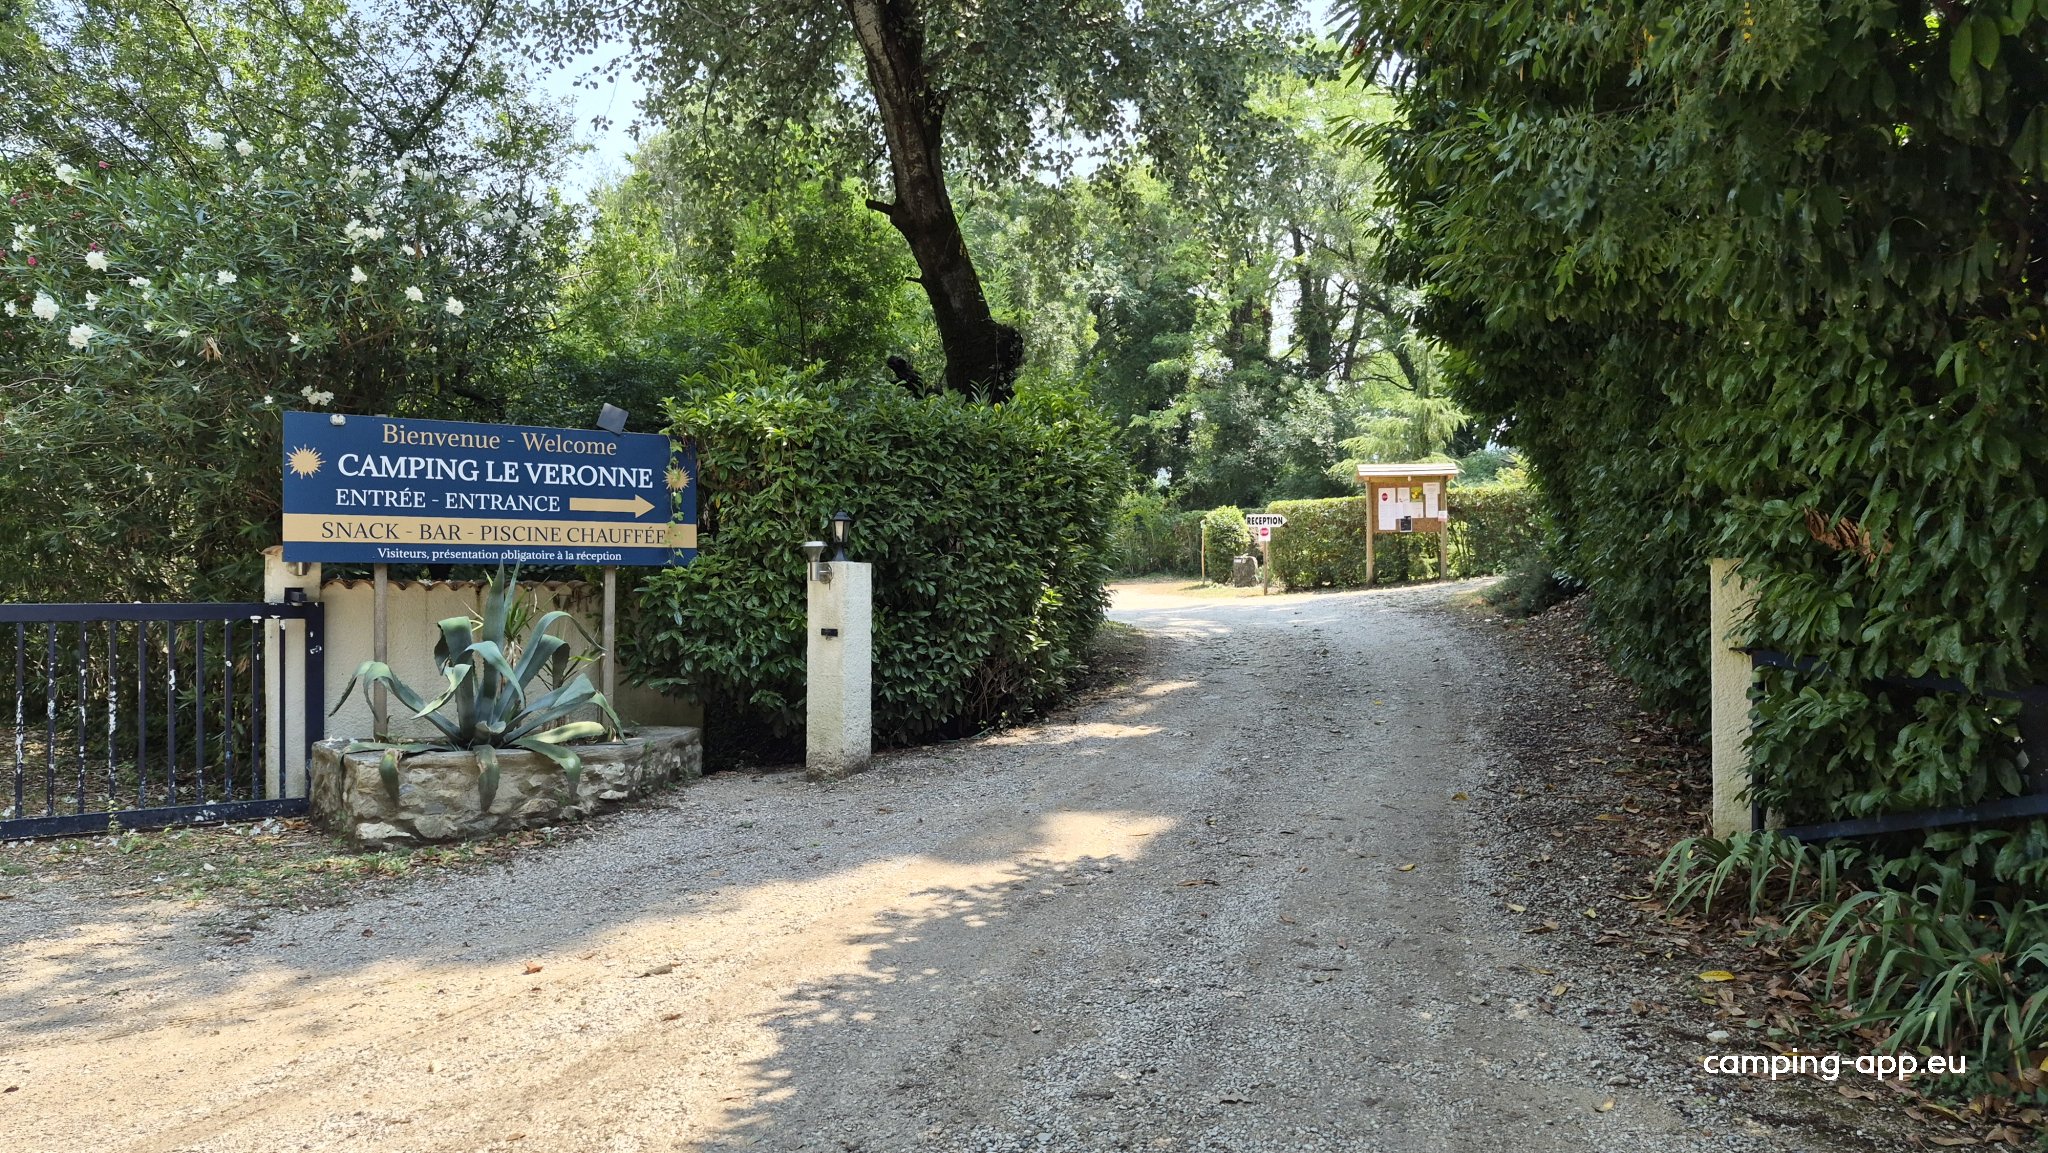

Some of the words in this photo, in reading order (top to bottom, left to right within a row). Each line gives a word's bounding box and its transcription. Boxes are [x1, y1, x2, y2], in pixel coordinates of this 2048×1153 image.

[382, 423, 500, 449] Bienvenue
[521, 432, 617, 456] Welcome
[338, 453, 480, 481] CAMPING
[485, 460, 519, 483] LE
[524, 462, 653, 489] VERONNE
[335, 487, 426, 508] ENTRÉE
[445, 492, 560, 512] ENTRANCE
[1246, 516, 1283, 524] RECEPTION
[321, 521, 400, 540] SNACK
[419, 523, 462, 541] BAR
[480, 525, 562, 543] PISCINE
[377, 548, 430, 560] Visiteurs,
[432, 549, 499, 562] présentation
[501, 549, 555, 562] obligatoire
[565, 550, 574, 560] la
[576, 550, 622, 563] réception
